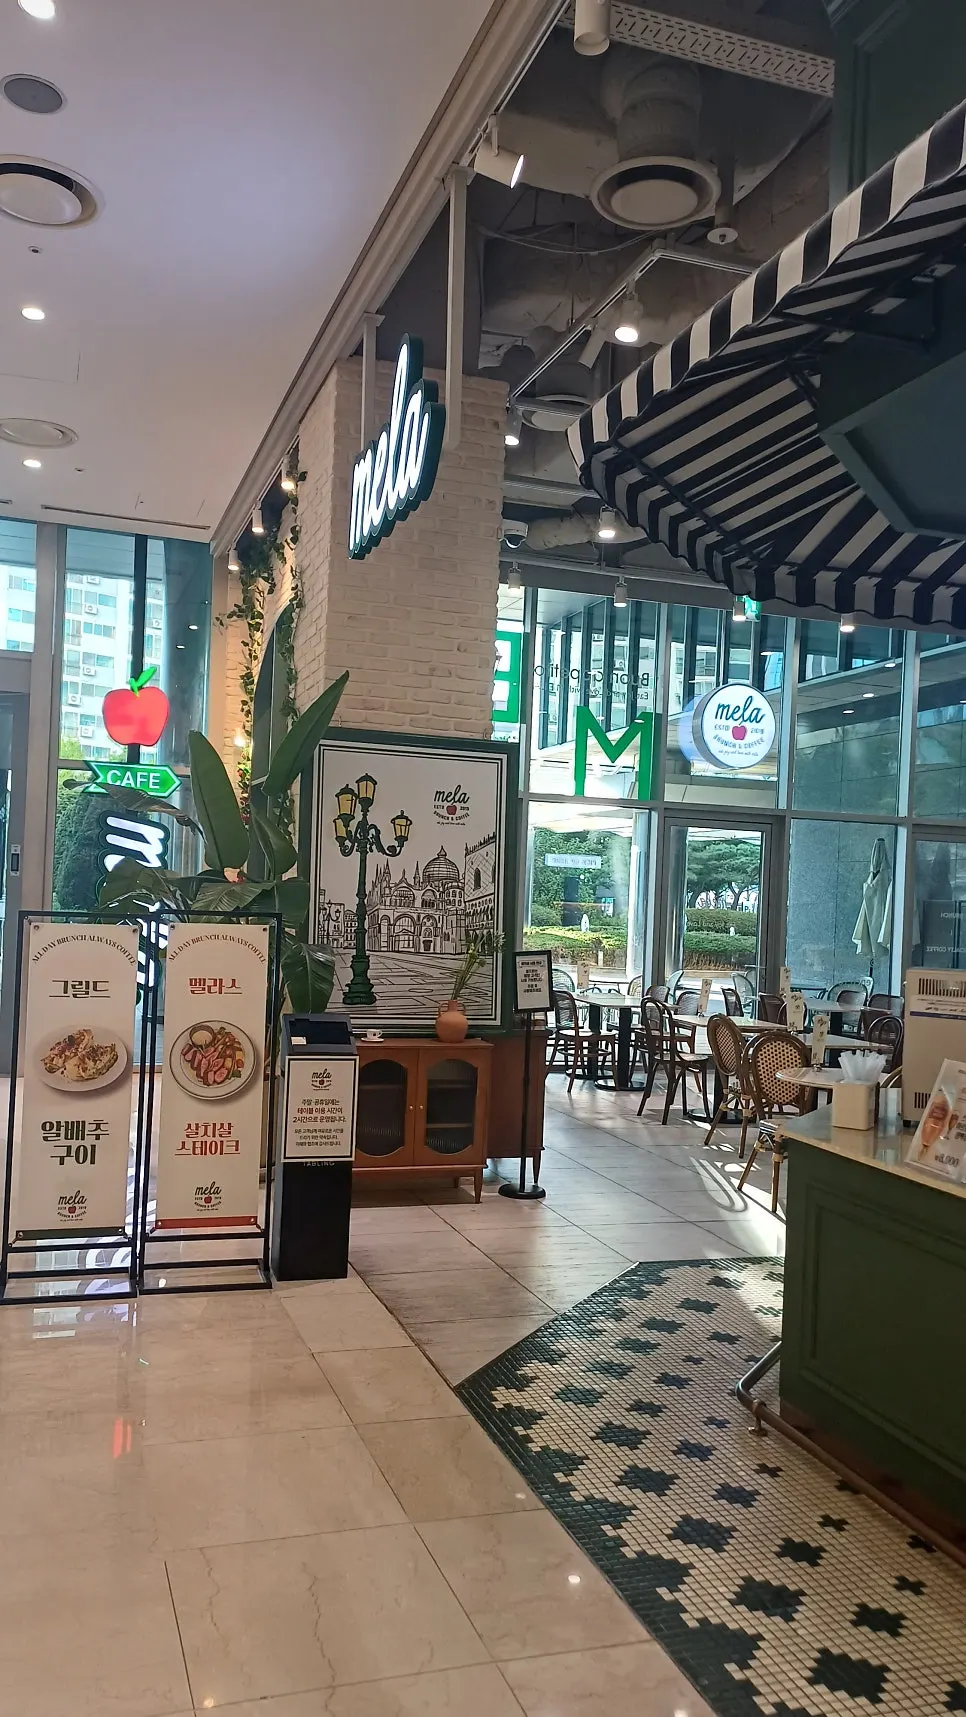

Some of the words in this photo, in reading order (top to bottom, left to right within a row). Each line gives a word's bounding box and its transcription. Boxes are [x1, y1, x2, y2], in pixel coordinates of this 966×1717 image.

[348, 335, 434, 557] mela
[715, 696, 766, 726] mela
[106, 769, 161, 790] CAFE
[433, 784, 470, 805] mela
[32, 952, 45, 964] ALL
[42, 941, 57, 954] DAY
[57, 934, 87, 946] BRUNCH
[88, 934, 118, 948] ALWAYS
[116, 944, 137, 967] COFFEE
[168, 950, 179, 963] ALL
[177, 939, 192, 953] DAY
[191, 934, 220, 945] BRUNCH
[221, 934, 249, 947] ALWAYS
[247, 943, 267, 964] COFFEE
[49, 980, 111, 999] 그릴드
[189, 977, 243, 995] 멜라스
[311, 1068, 332, 1080] mela
[292, 1116, 319, 1124] 2시간으로
[297, 1107, 314, 1115] 테이블
[314, 1107, 326, 1115] 이용
[326, 1107, 343, 1115] 시간이
[41, 1119, 110, 1142] 알배추
[184, 1122, 234, 1138] 살치살
[50, 1144, 97, 1166] 구이
[174, 1139, 241, 1156] 스테이크
[58, 1189, 87, 1205] mela
[194, 1181, 222, 1196] mela
